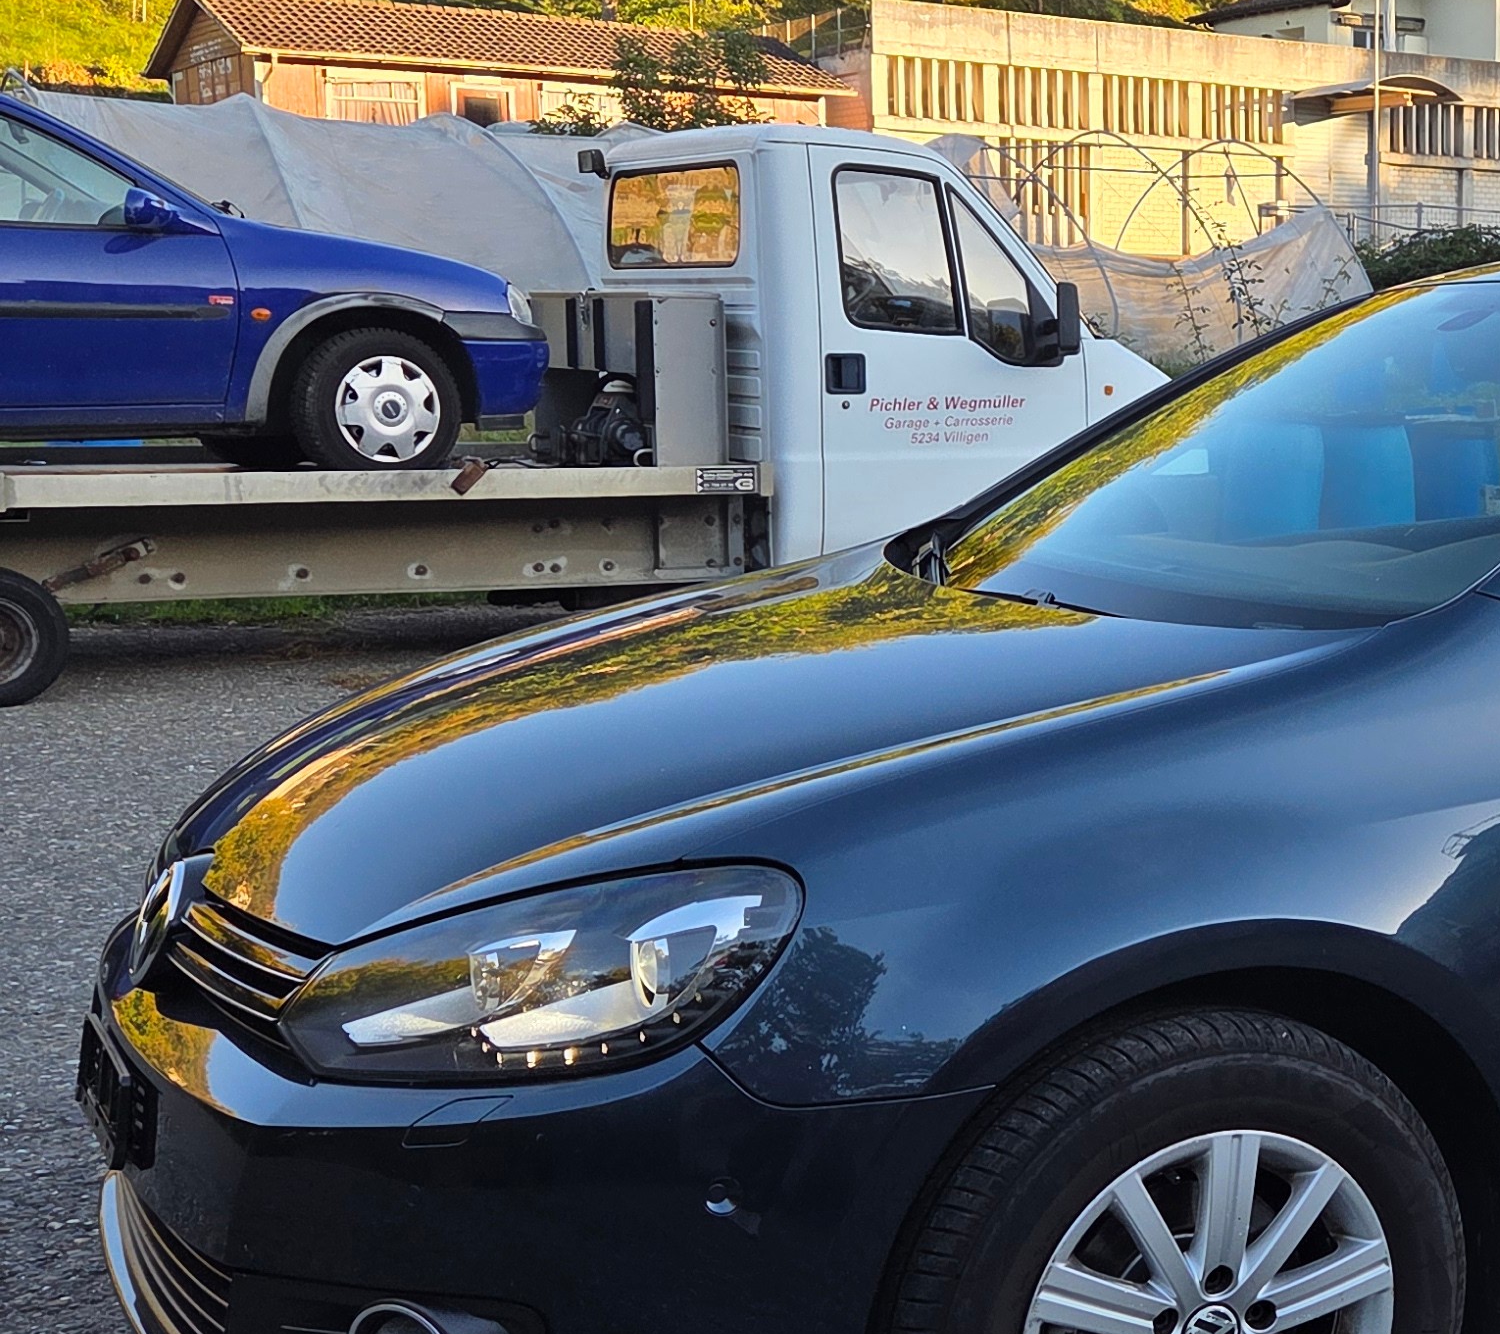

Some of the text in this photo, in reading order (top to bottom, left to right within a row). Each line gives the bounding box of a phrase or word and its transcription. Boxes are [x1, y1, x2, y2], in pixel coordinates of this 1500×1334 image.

[869, 395, 1026, 412] Pichler & Wegmüller
[884, 417, 930, 430] Garage
[944, 414, 1013, 429] Carrosserie
[910, 431, 989, 445] 5234 Villigen
